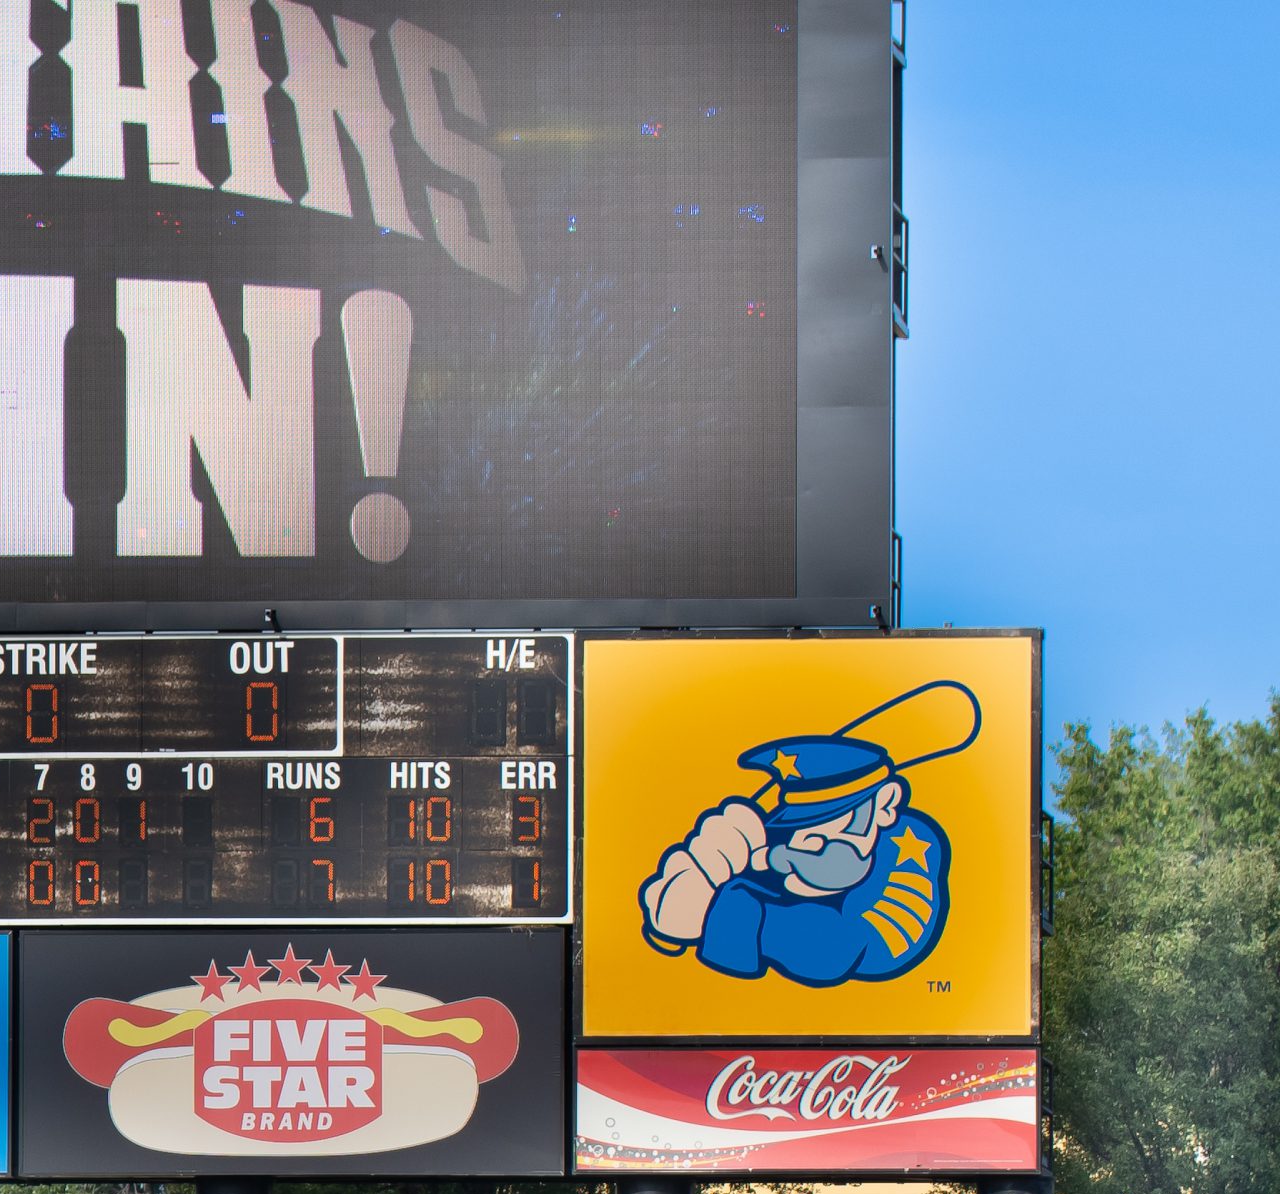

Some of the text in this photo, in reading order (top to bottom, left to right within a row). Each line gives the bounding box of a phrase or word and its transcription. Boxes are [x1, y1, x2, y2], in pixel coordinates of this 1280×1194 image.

[229, 641, 295, 675] OUT
[486, 638, 536, 672] H/E
[26, 683, 58, 743] 0
[246, 681, 279, 742] 0
[34, 765, 50, 791] 7
[79, 764, 96, 791] 8
[125, 764, 142, 791] 9
[181, 763, 214, 790] 10
[266, 762, 341, 790] RUNS
[389, 761, 451, 789] HITS
[501, 760, 557, 789] ERR
[29, 798, 54, 843] 2
[75, 798, 100, 843] 0
[309, 797, 335, 842] 6
[408, 797, 451, 842] 10
[518, 796, 540, 842] 3
[29, 860, 54, 905] 0
[75, 860, 100, 905] 0
[312, 859, 334, 902] 7
[408, 859, 451, 905] 10
[926, 980, 951, 993] TM
[213, 1018, 367, 1062] FIVE
[201, 1064, 376, 1110] STAR
[705, 1054, 913, 1123] Coca-Cola
[240, 1112, 333, 1131] BRAND
